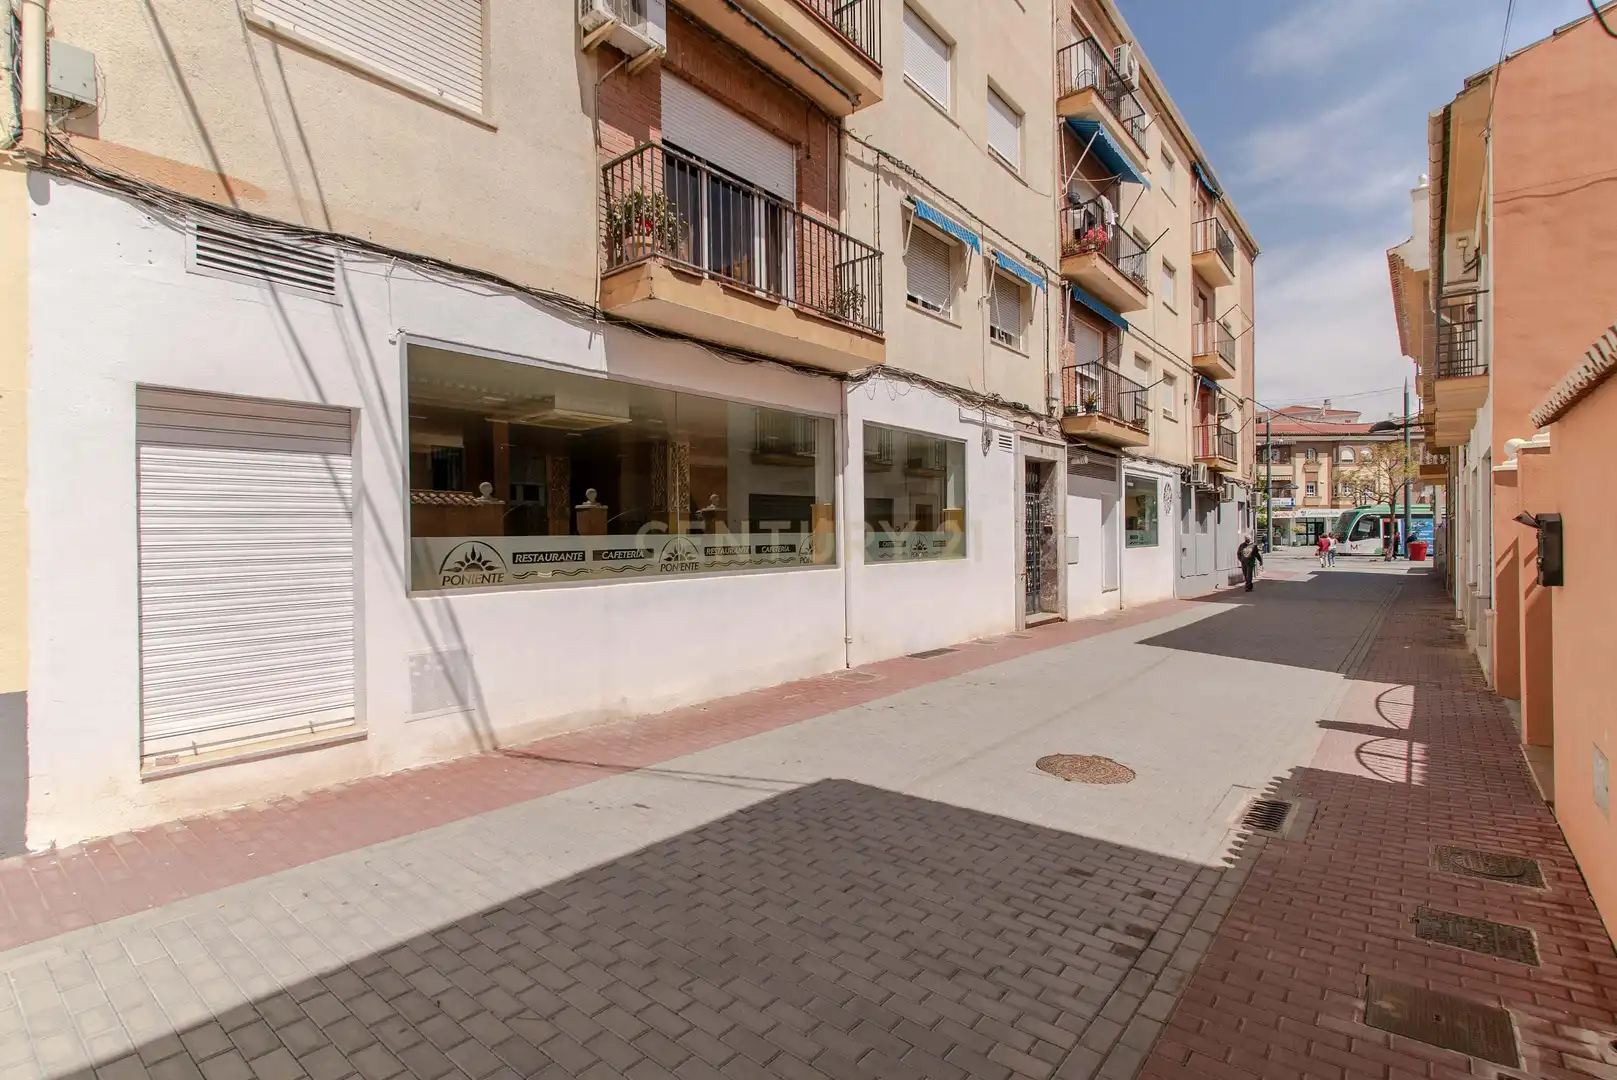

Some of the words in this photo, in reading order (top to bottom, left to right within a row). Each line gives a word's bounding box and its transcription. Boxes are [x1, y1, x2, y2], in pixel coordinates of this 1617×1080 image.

[514, 551, 583, 564] RESTAURANTE
[601, 549, 645, 560] CAFETERÍA
[660, 562, 699, 572] PONENTE
[441, 572, 504, 587] PONIENTE
